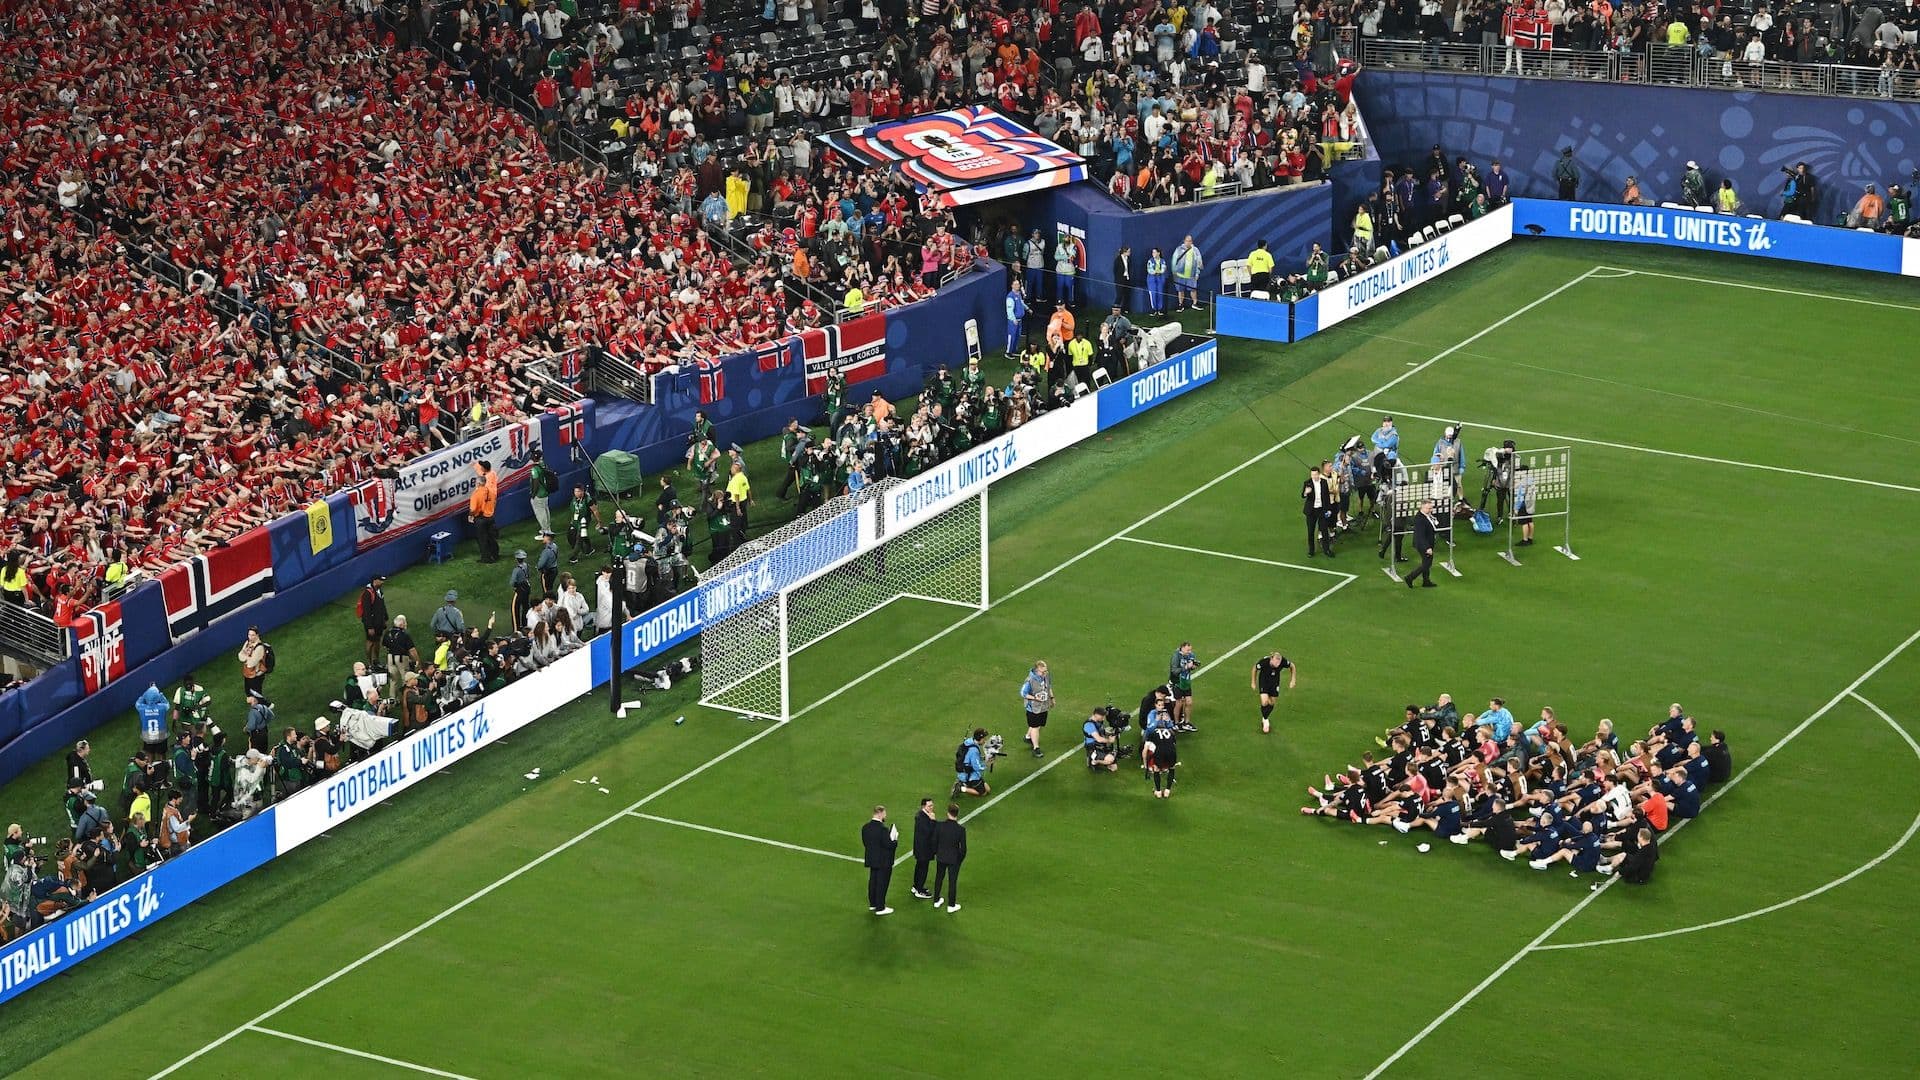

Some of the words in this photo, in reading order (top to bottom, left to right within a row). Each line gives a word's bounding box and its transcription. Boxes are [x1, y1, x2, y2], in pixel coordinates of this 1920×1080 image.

[1570, 207, 1668, 238] FOOTBALL
[1674, 215, 1741, 247] UNITES
[1348, 266, 1397, 309] FOOTBALL
[1401, 247, 1434, 284] UNITES
[856, 346, 880, 361] KOKOS
[1131, 360, 1189, 408] FOOTBALL
[395, 473, 418, 492] ALT
[421, 460, 449, 482] FOR
[452, 436, 501, 470] NORGE
[896, 468, 955, 522] FOOTBALL
[959, 446, 999, 488] UNITES
[414, 477, 477, 511] Oljeberge
[633, 596, 701, 657] FOOTBALL
[706, 570, 752, 619] UNITES
[327, 751, 407, 818] FOOTBALL
[412, 718, 465, 772] UNITES
[66, 894, 131, 957] UNITES
